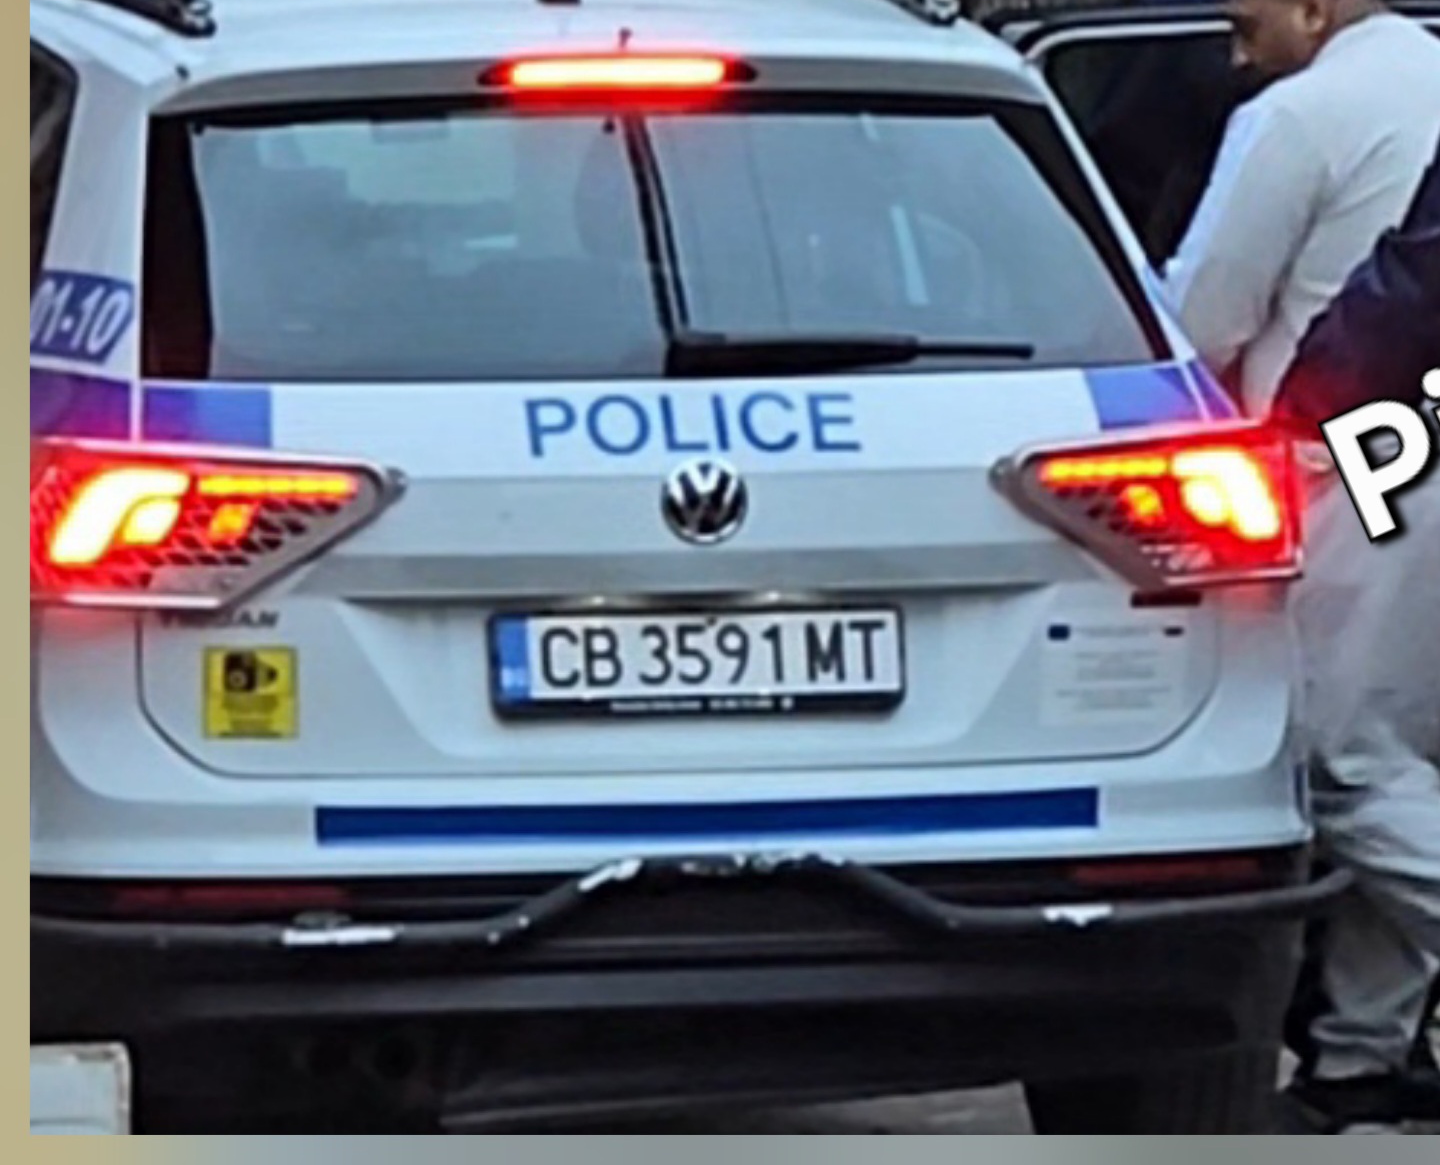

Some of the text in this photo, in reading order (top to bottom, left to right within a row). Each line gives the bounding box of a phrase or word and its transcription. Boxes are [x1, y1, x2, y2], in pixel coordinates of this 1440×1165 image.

[524, 391, 862, 458] POLICE
[540, 620, 886, 688] CB 3591 MT
